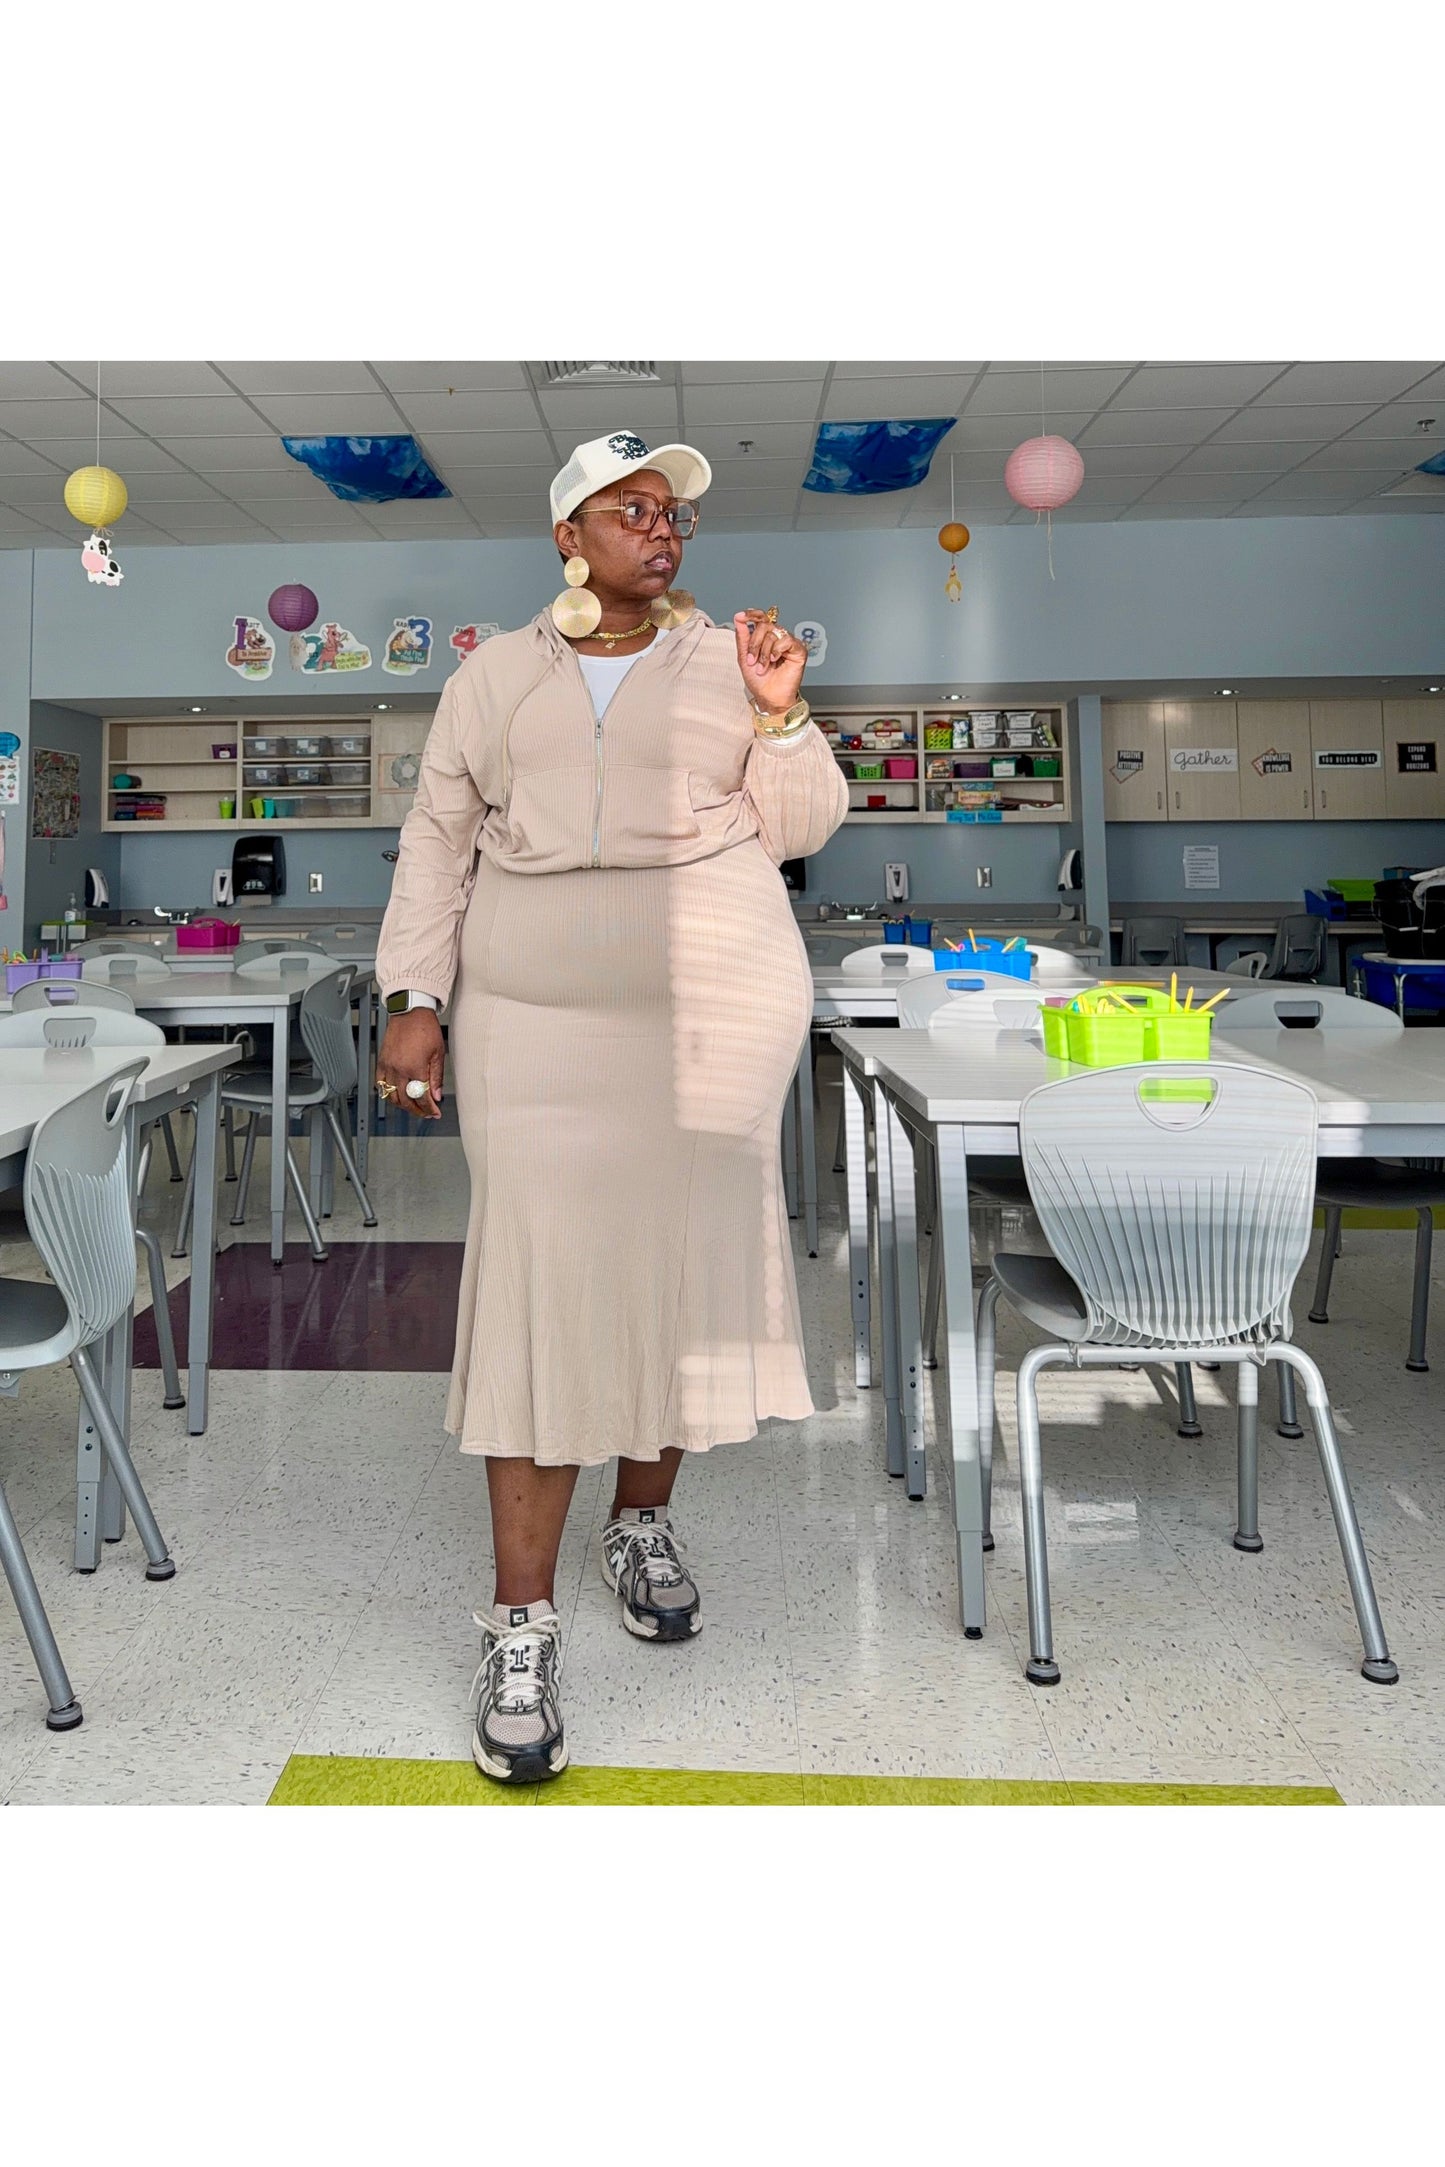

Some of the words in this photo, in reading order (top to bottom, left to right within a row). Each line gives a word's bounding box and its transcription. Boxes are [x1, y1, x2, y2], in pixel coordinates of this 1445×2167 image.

[408, 618, 431, 649] 3
[452, 626, 478, 652] 4
[303, 635, 324, 670] 2
[1174, 750, 1232, 770] Gather
